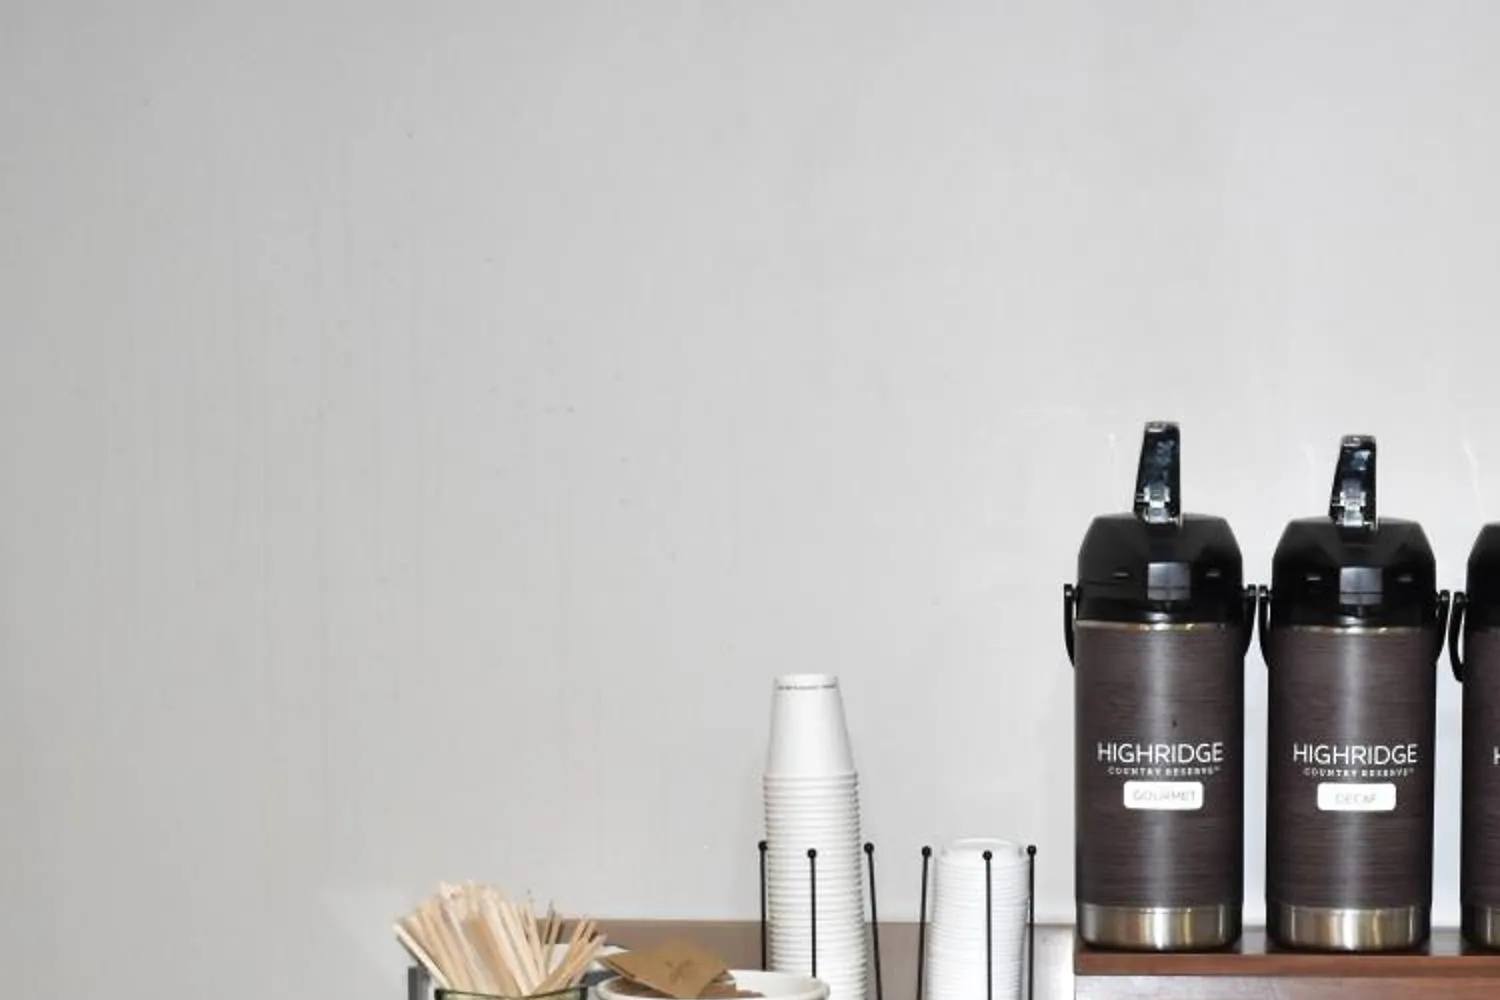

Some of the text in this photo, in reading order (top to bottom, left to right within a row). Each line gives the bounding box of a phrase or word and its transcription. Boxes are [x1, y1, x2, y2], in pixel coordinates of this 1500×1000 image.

[1097, 741, 1224, 764] HIGHRIDGE
[1293, 743, 1419, 765] HIGHRIDGE
[1107, 766, 1162, 776] COUNTRY
[1303, 767, 1357, 777] COUNTRY
[1133, 789, 1196, 801] GOURMET
